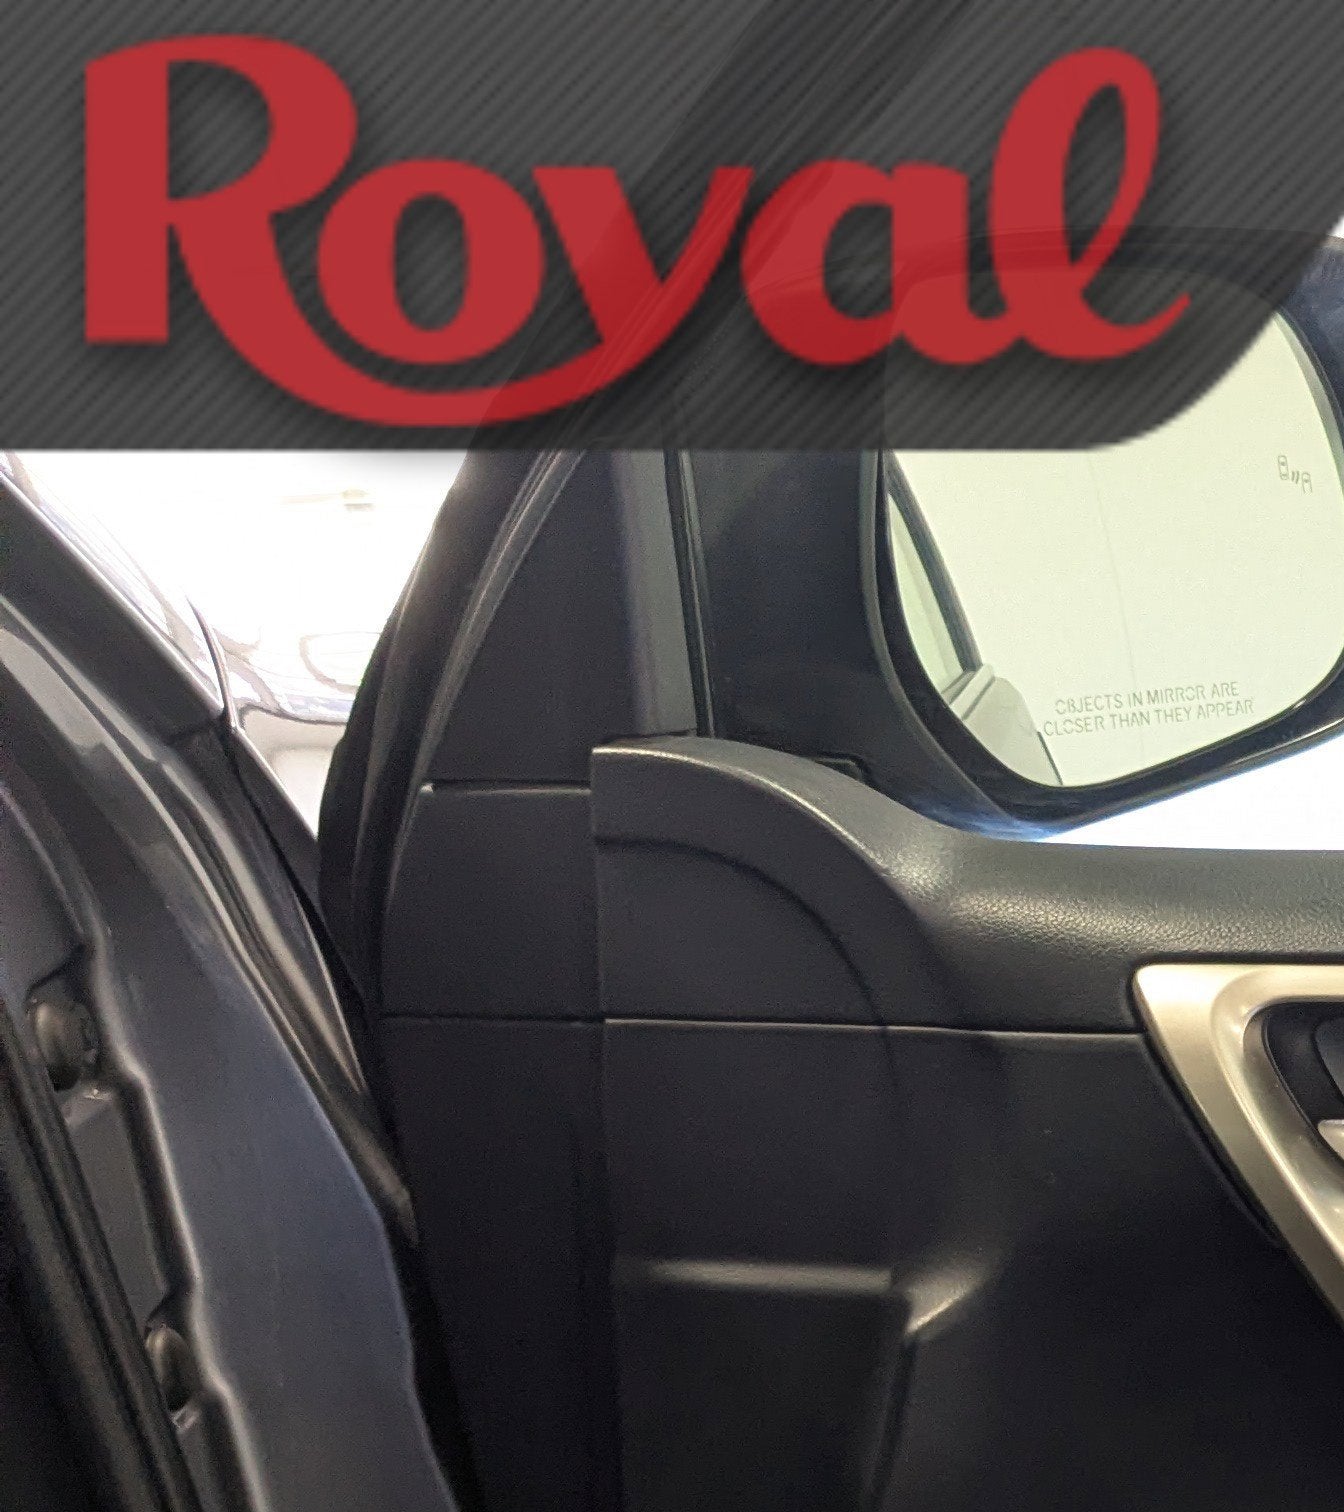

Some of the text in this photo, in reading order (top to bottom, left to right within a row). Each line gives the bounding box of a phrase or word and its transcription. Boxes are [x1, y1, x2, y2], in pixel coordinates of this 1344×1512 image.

[1055, 681, 1239, 715] OBJECTS IN MIRROR ARE
[1043, 699, 1255, 737] CLOSER THAN THEY APPEAR
